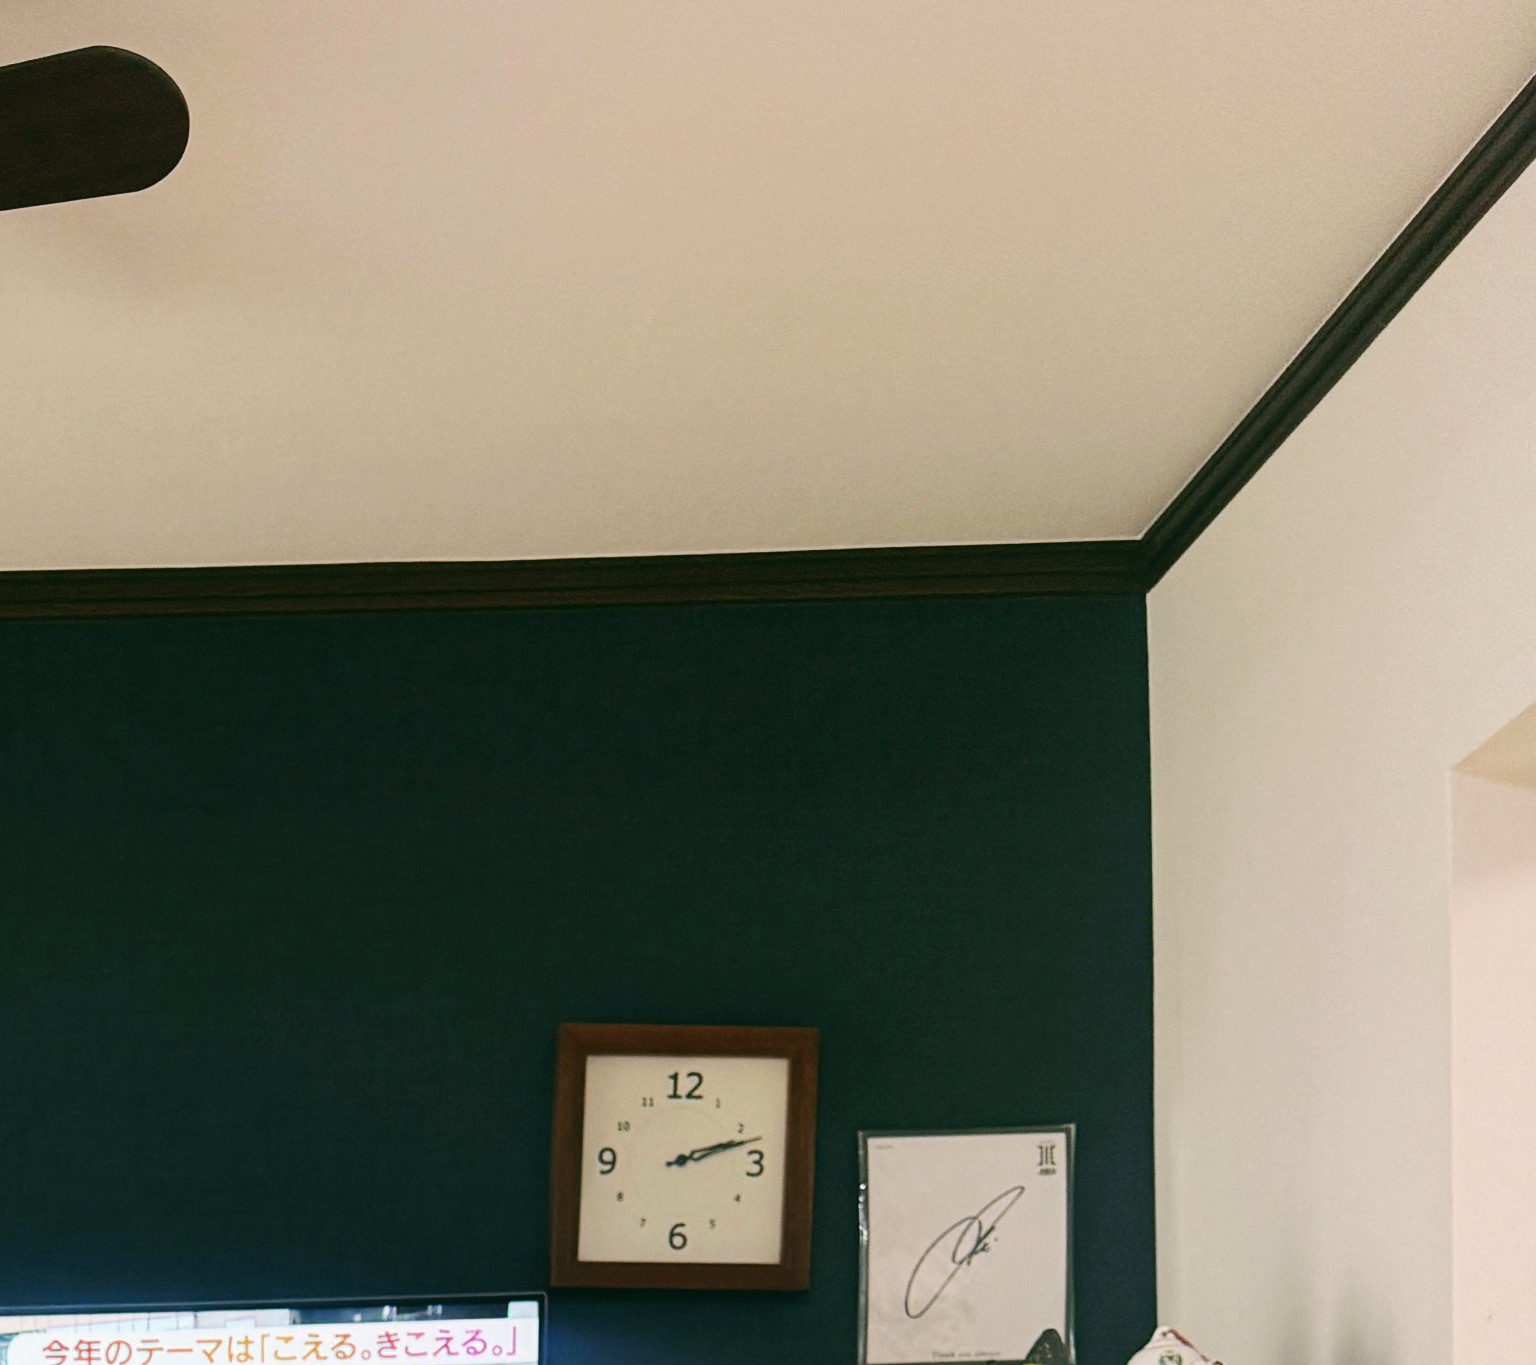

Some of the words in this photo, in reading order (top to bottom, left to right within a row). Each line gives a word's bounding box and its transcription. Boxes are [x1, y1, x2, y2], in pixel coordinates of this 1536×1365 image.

[667, 1072, 704, 1100] 12
[641, 1097, 654, 1108] 11
[617, 1121, 631, 1132] 10
[598, 1147, 618, 1175] 9
[745, 1149, 765, 1178] 3
[668, 1222, 688, 1251] 6
